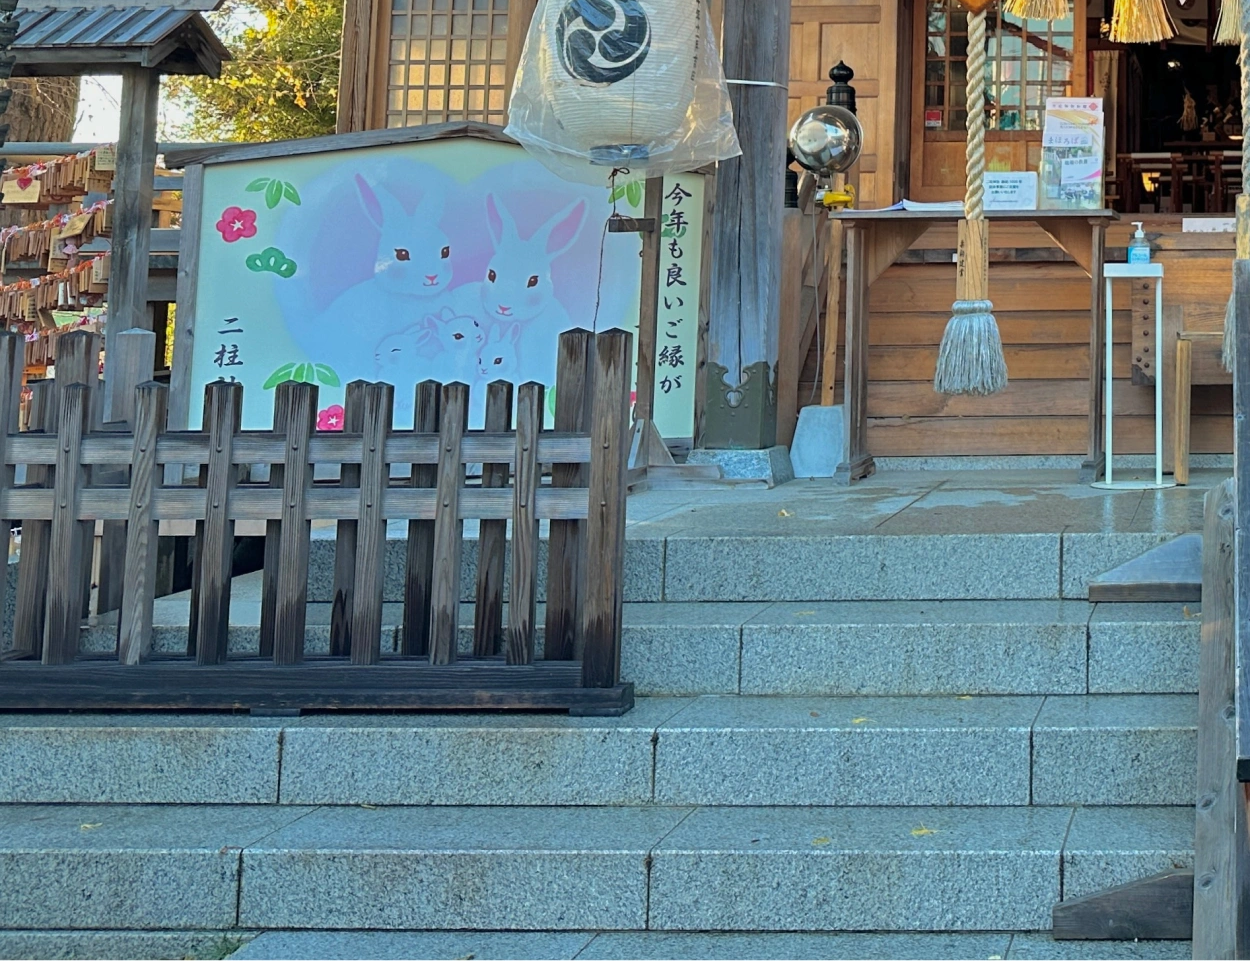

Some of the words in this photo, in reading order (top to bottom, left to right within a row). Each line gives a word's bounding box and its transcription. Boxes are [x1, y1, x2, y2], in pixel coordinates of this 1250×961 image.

[213, 317, 244, 384] 二柱
[657, 182, 692, 394] 今年も良いご縁が
